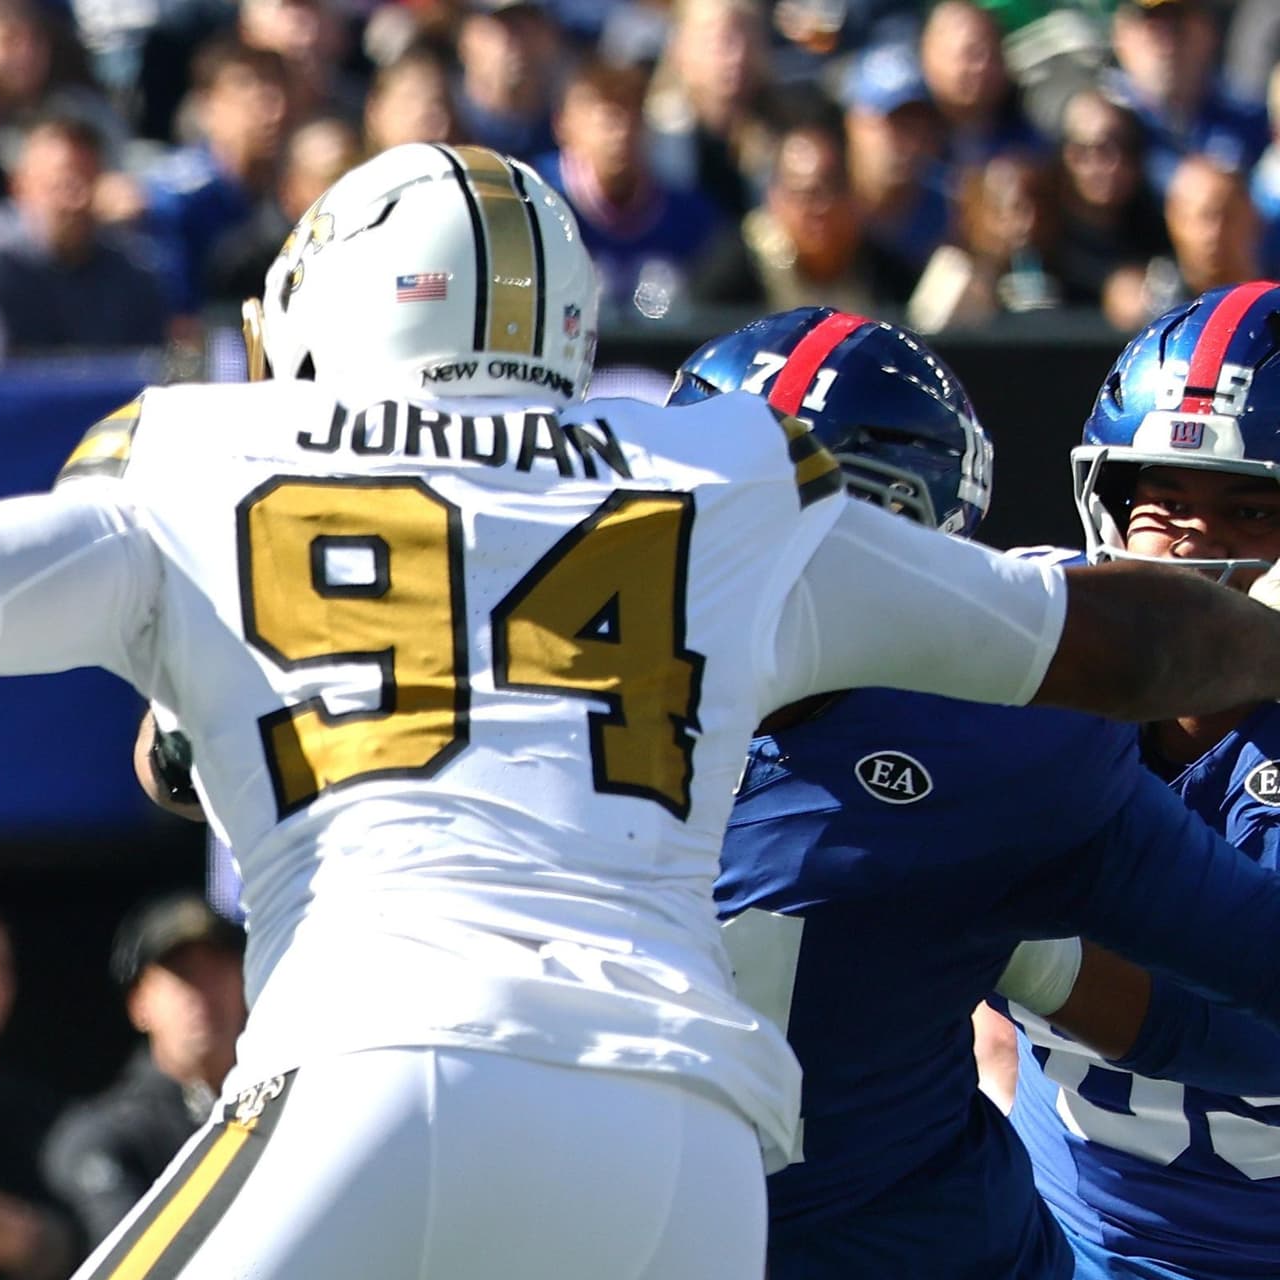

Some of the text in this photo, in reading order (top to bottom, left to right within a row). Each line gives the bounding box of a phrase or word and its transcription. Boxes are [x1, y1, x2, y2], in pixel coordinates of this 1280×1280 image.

[421, 360, 575, 399] NEW ORLEANS
[740, 351, 838, 413] 71
[296, 399, 633, 480] JORDAN
[236, 475, 706, 823] 94
[868, 759, 917, 796] EA
[1258, 769, 1280, 795] E
